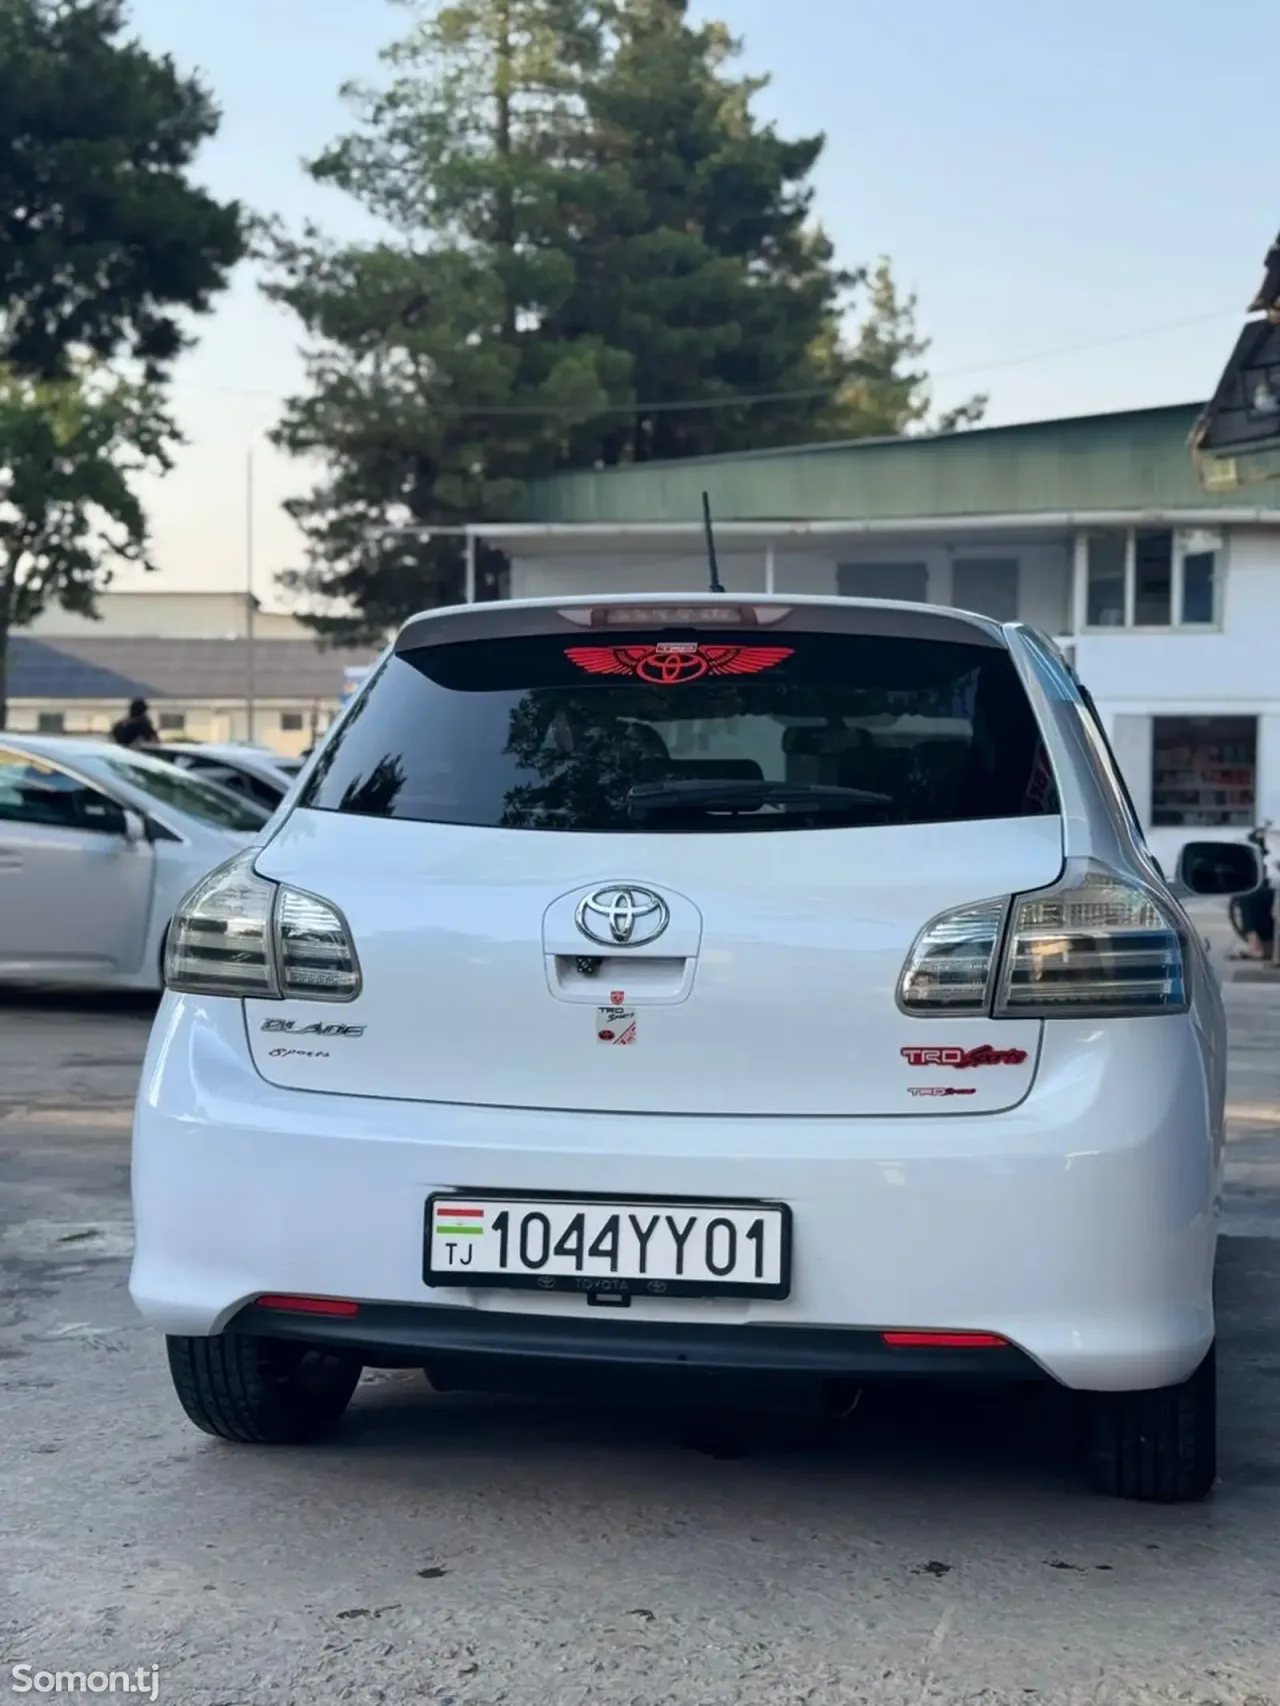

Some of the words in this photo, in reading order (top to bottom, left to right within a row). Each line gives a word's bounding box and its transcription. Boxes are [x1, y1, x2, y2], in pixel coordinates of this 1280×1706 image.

[261, 1018, 367, 1037] BLADE
[901, 1047, 965, 1066] TRD
[491, 1210, 764, 1278] 1044YY01
[445, 1243, 473, 1265] TJ
[575, 1278, 628, 1290] TOYOTA
